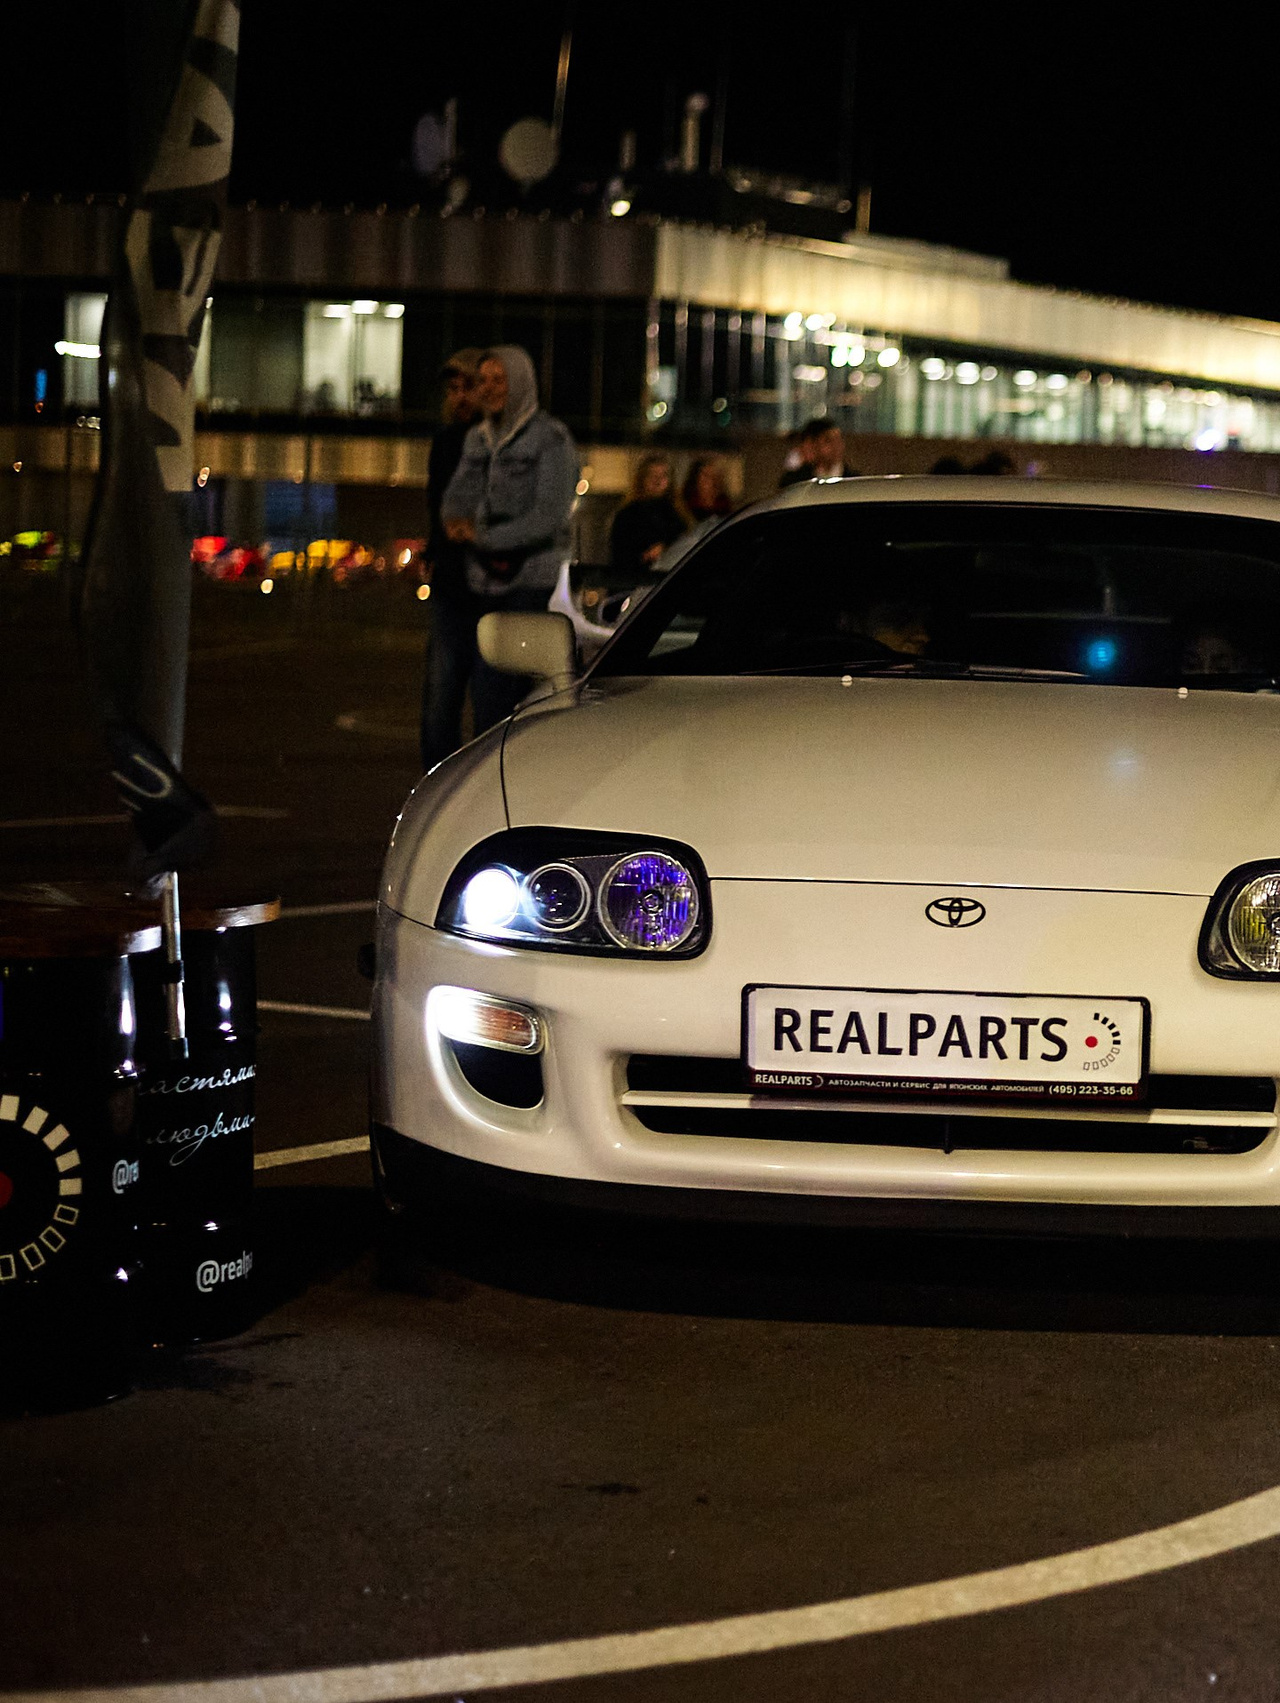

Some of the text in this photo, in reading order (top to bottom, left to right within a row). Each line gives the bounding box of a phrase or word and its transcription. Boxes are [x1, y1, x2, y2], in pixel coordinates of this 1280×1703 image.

[773, 1007, 1069, 1063] REALPARTS
[754, 1074, 1134, 1097] REALPARTS АВТОЗАПЧАСТИ И СЕРВИС ДЛЯ ЯПОНСКИХ АВТОМОБИЛЕЙ (495) 223-35-66
